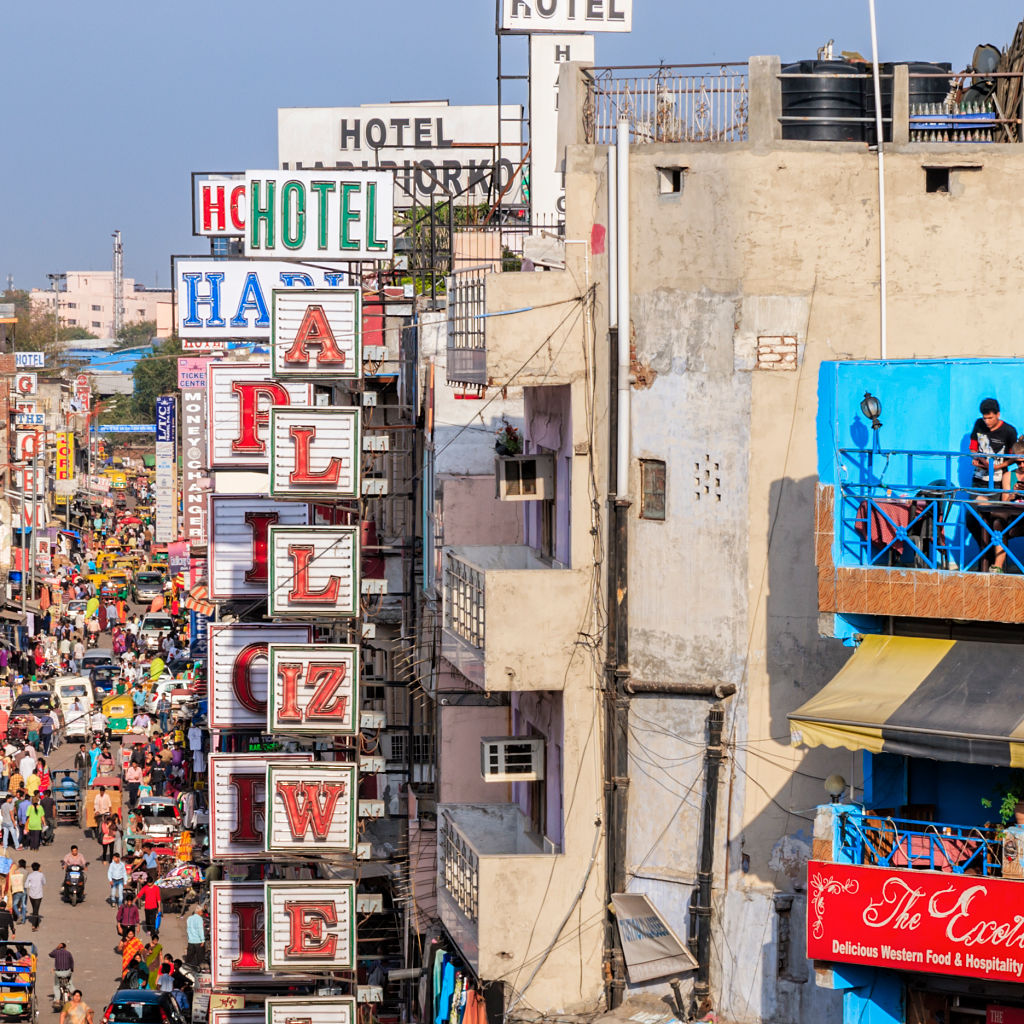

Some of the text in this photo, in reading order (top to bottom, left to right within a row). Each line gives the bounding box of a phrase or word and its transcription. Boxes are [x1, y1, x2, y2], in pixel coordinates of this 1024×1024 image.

[339, 117, 454, 151] HOTEL
[250, 178, 388, 252] HOTEL
[182, 271, 345, 328] HA
[15, 353, 44, 367] HOTEL
[17, 414, 44, 424] THE
[184, 392, 202, 447] MONEY
[862, 876, 926, 931] The
[832, 939, 1023, 977] Delicious Western Food & Hospitality
[990, 1010, 1004, 1023] THE
